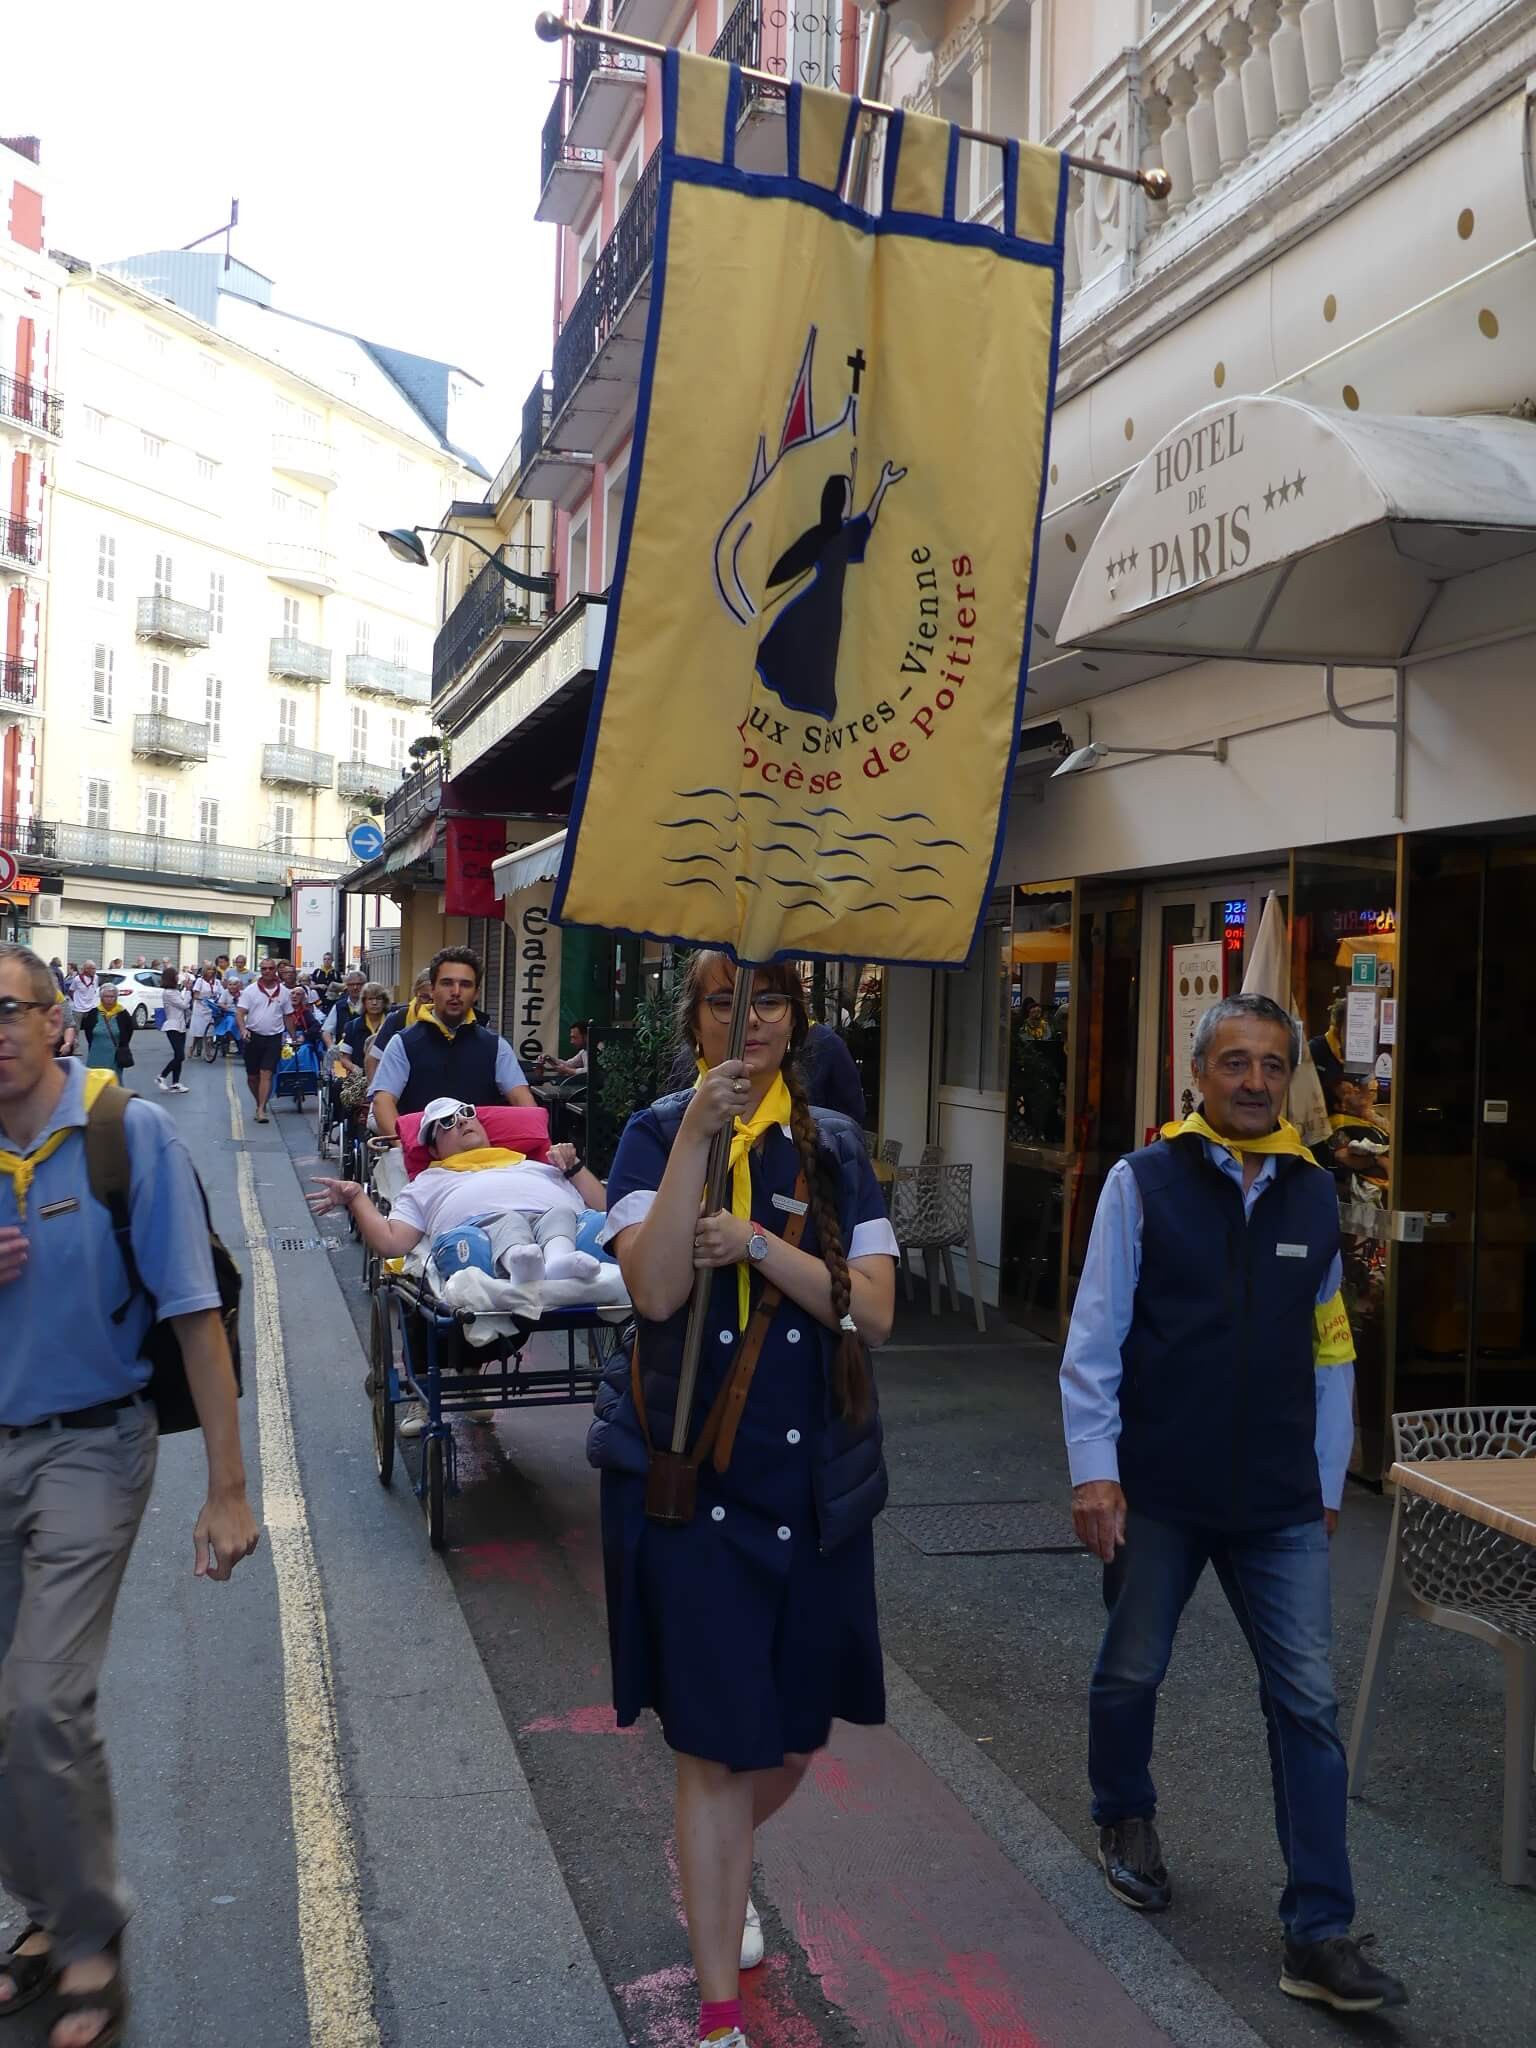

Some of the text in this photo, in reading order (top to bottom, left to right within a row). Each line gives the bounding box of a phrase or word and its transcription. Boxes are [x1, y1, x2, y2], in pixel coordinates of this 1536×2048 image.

[1154, 411, 1244, 494] HOTEL
[1188, 485, 1207, 514] DE
[1149, 504, 1250, 600] PARIS
[748, 706, 790, 745] ux
[900, 545, 938, 677] Vienne
[862, 739, 911, 779] de
[910, 554, 976, 740] Poitiers
[519, 907, 546, 1061] Caffé
